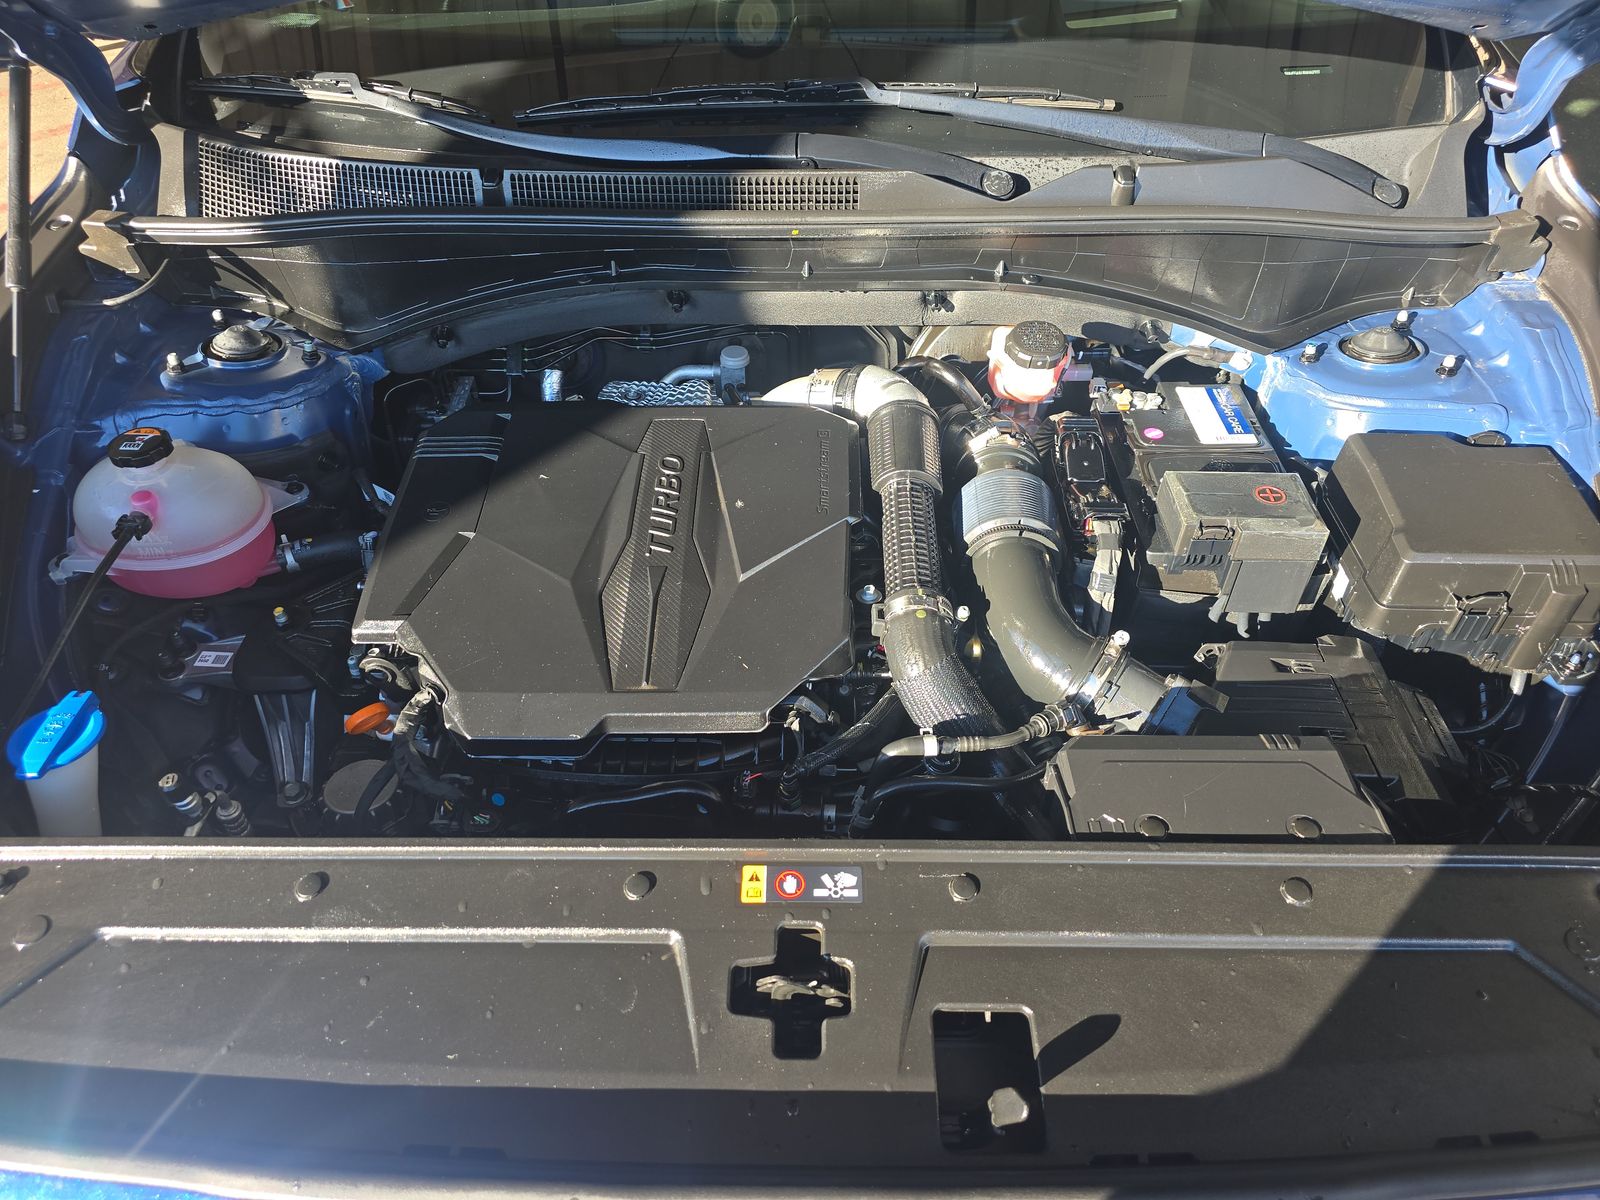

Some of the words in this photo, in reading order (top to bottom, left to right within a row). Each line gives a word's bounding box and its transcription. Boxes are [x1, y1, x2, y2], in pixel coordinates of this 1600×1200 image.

[1227, 416, 1244, 433] CARE
[645, 453, 685, 557] TURBO
[816, 440, 830, 515] Smartstream
